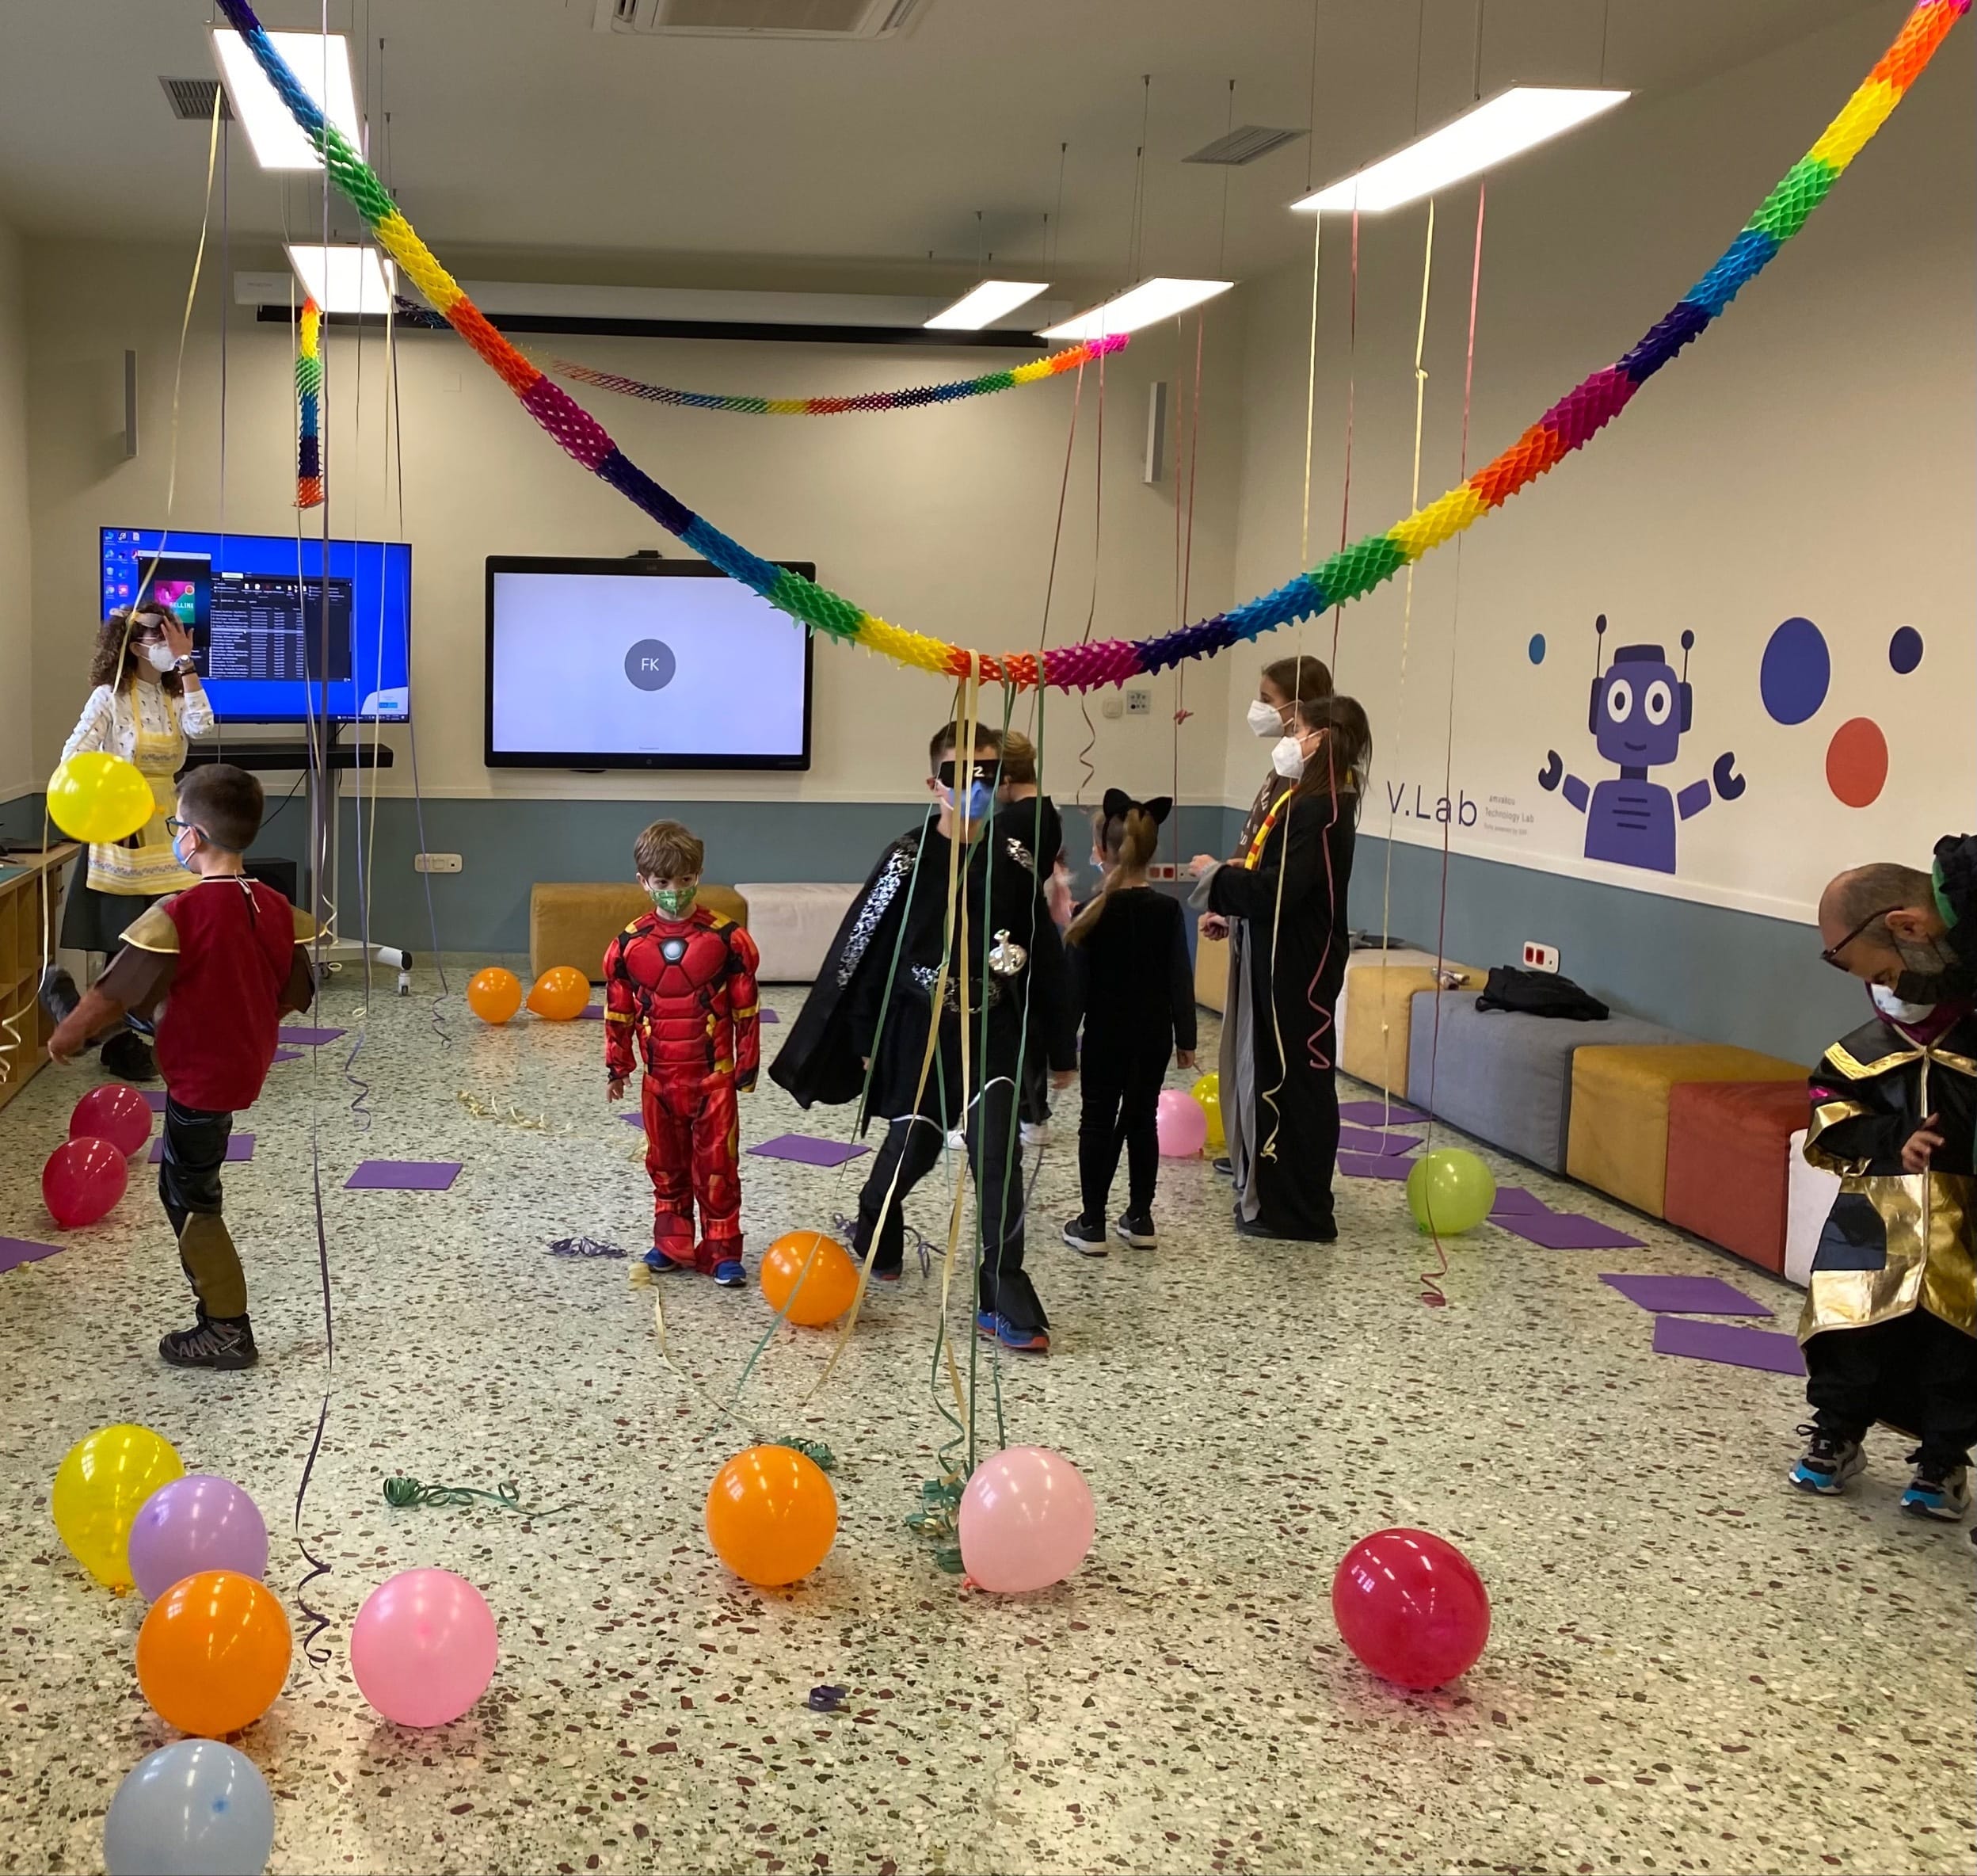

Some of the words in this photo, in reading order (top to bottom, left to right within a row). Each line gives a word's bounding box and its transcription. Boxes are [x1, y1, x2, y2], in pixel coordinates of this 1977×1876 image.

[642, 658, 660, 672] FK
[1387, 780, 1477, 827] V.Lab
[1485, 806, 1520, 824] Technology
[1522, 812, 1534, 823] Lab
